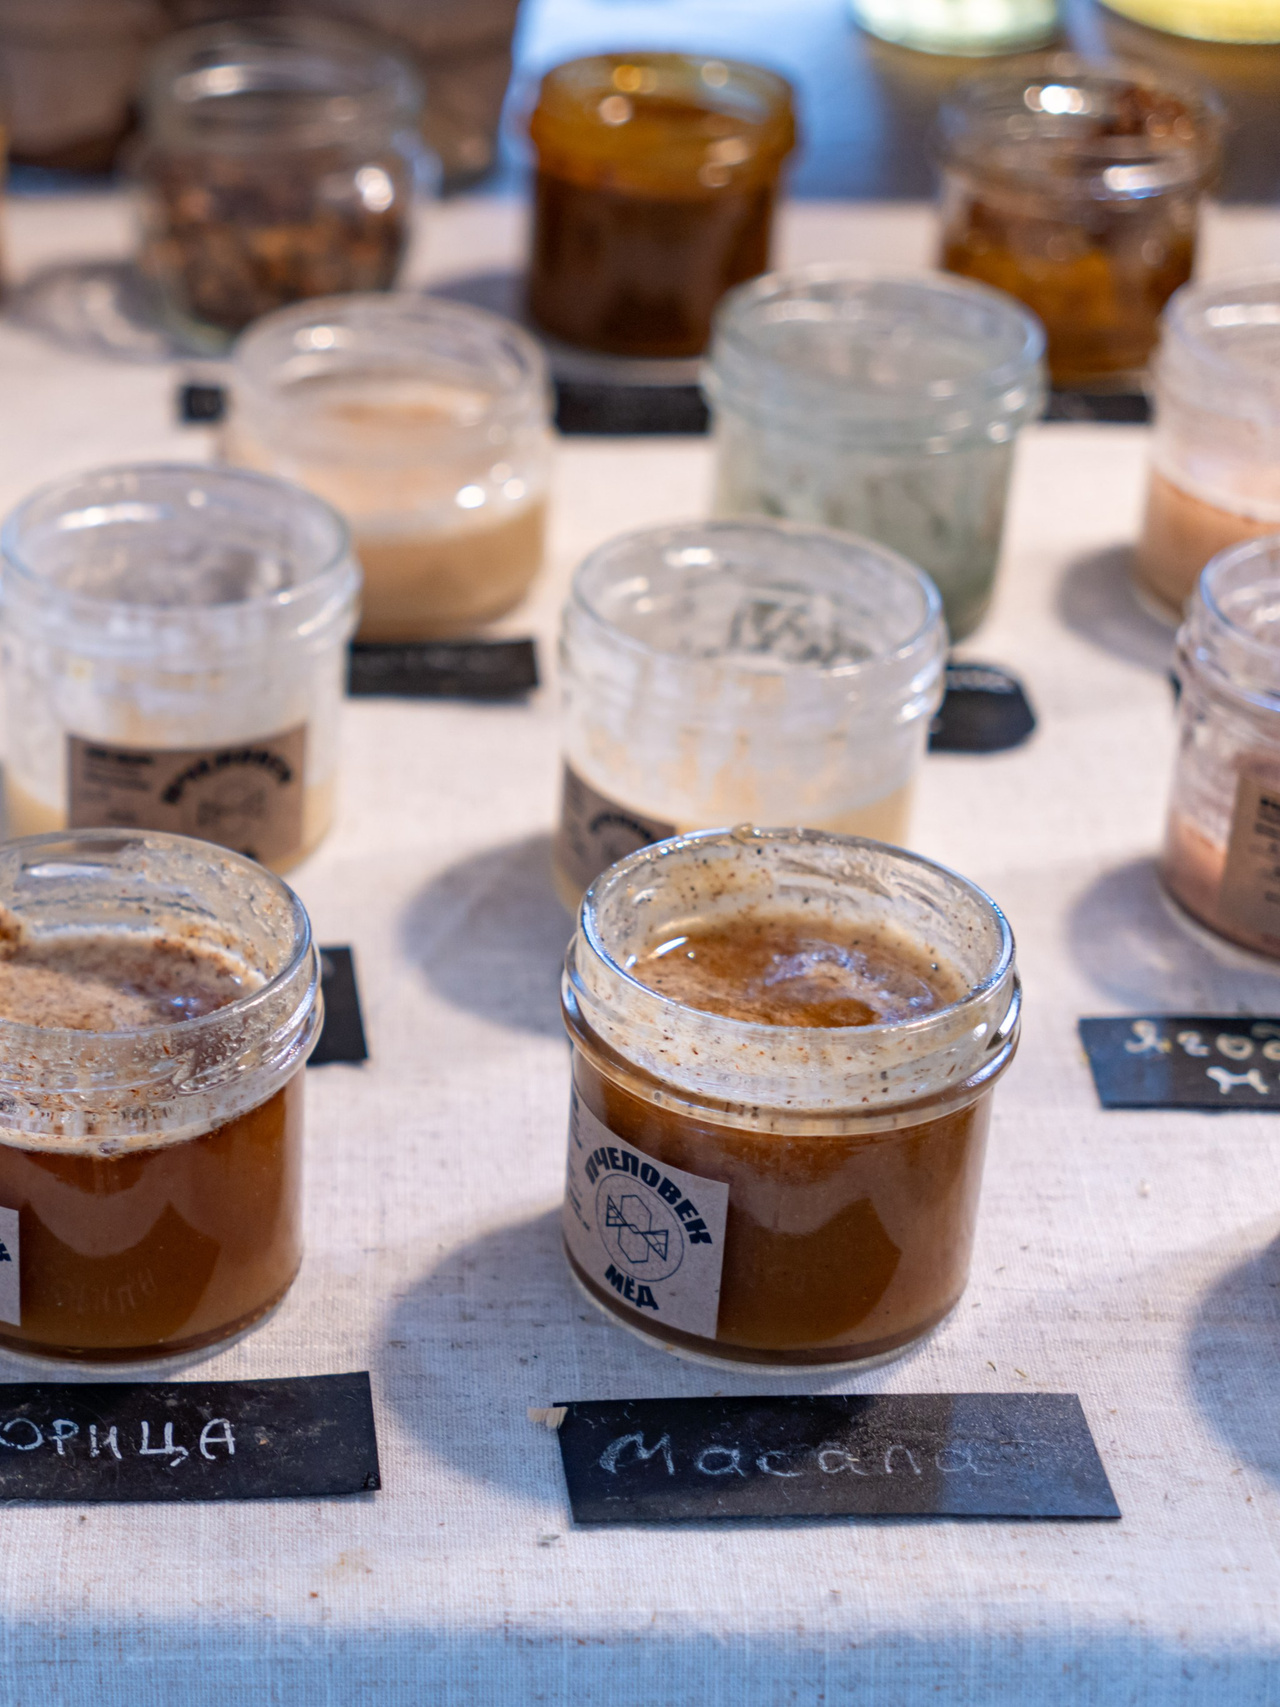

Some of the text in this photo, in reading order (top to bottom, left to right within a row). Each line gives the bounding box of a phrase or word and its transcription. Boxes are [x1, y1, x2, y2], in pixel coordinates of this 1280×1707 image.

[584, 1146, 713, 1245] ПЧЕЛОВЕК
[604, 1263, 660, 1311] МЁД
[598, 1431, 1002, 1478] Масала
